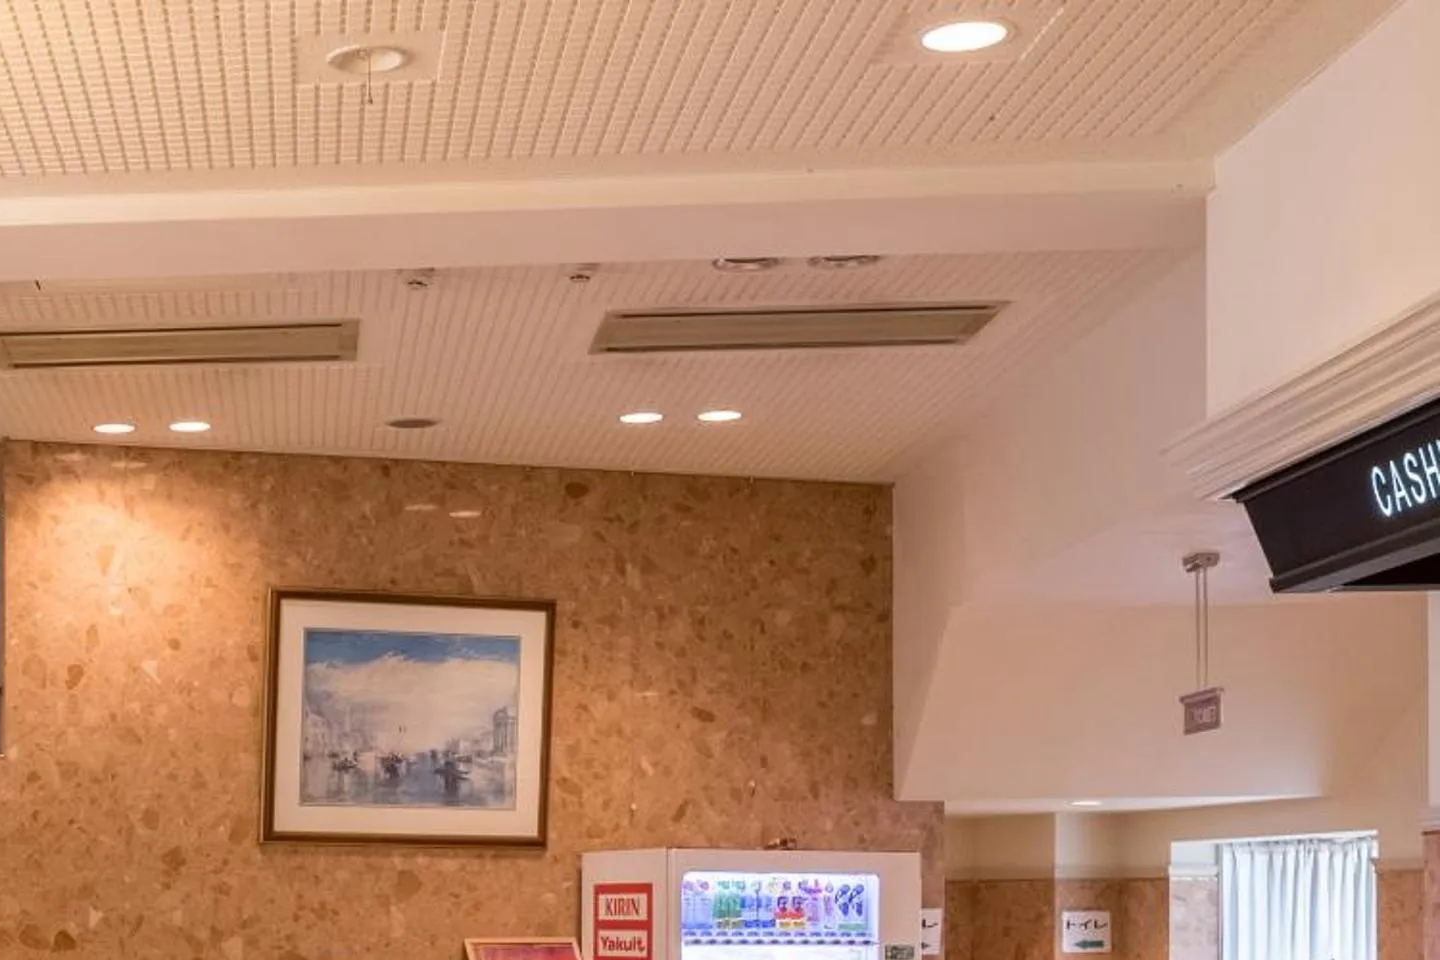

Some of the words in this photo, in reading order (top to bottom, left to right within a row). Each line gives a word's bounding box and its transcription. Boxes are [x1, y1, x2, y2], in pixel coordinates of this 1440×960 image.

[1371, 439, 1440, 517] CASH
[604, 897, 641, 916] KIRIN
[1066, 918, 1108, 930] トイレ
[600, 935, 646, 952] Yakult
